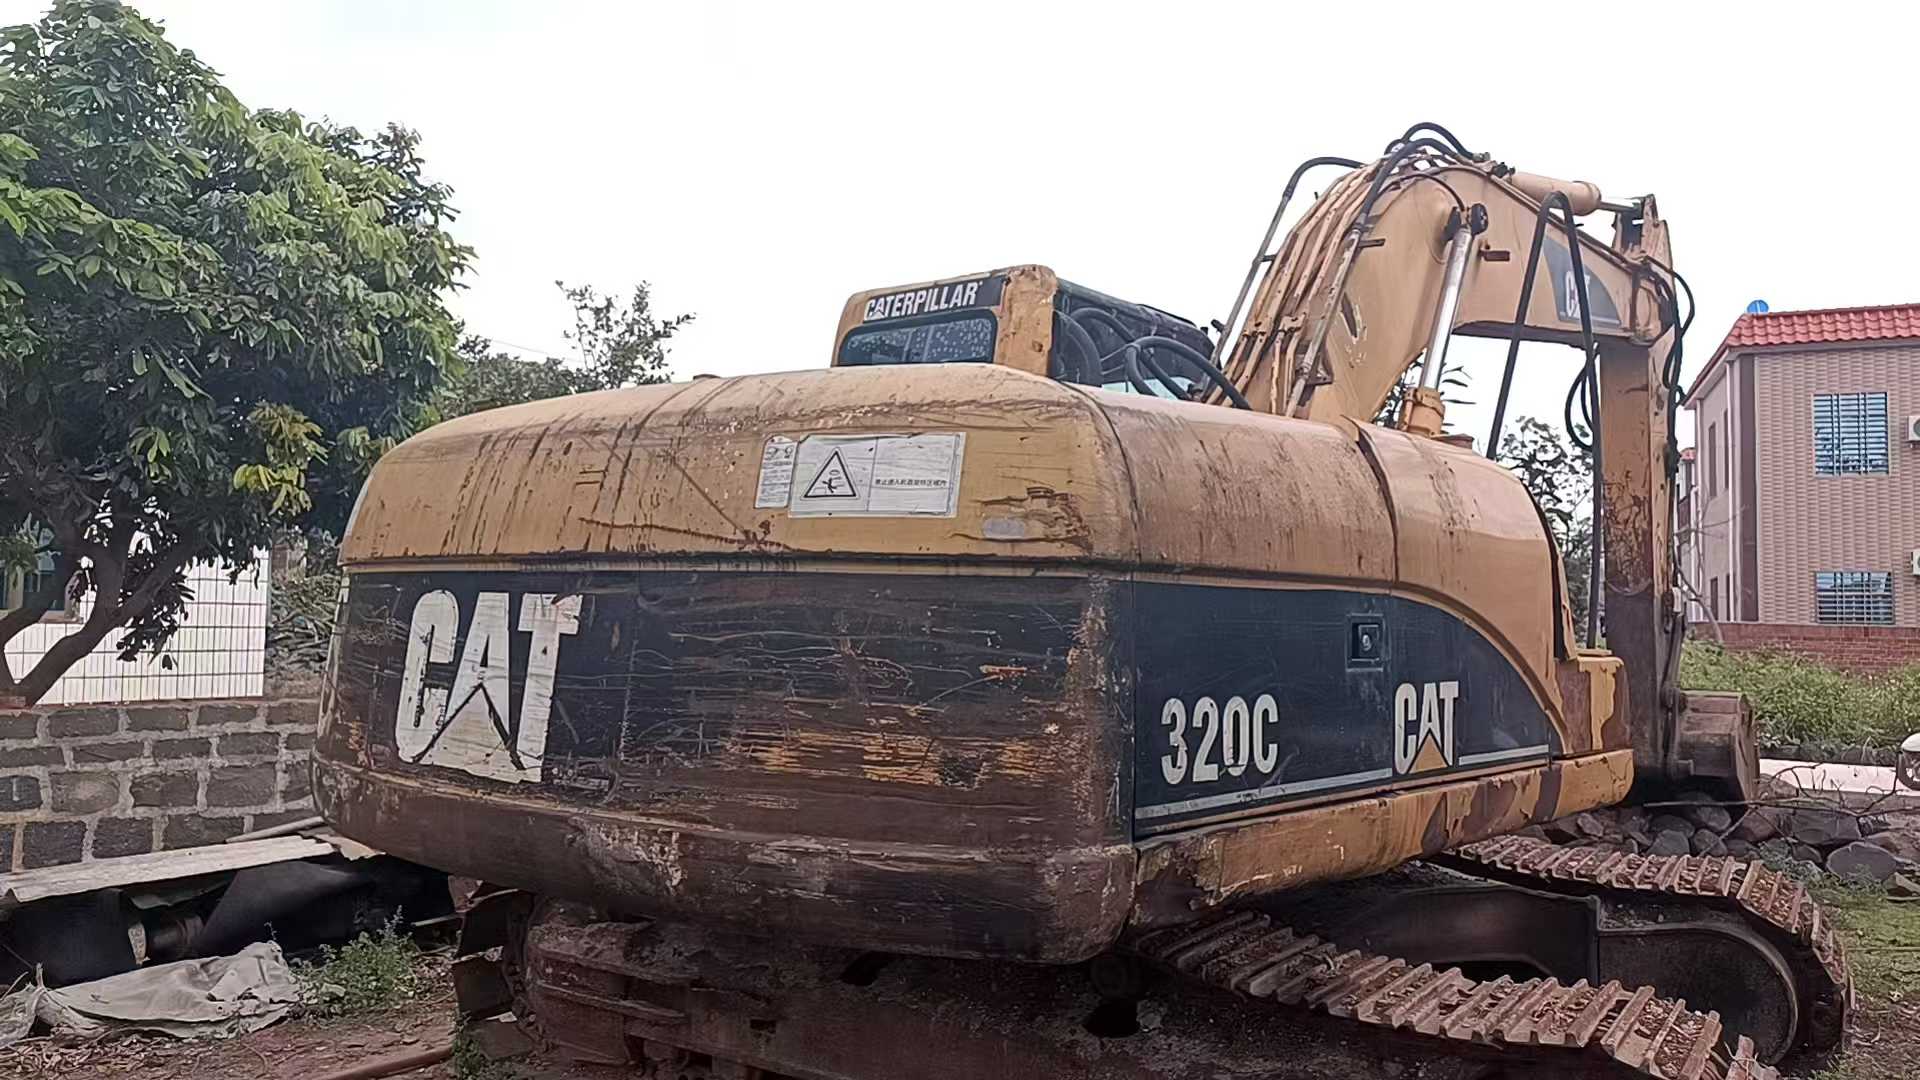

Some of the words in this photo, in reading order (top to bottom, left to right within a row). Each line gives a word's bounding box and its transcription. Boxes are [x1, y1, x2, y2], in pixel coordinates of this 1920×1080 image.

[863, 281, 979, 322] CATERPILLAR
[395, 589, 583, 783] CAT
[1394, 680, 1459, 776] CAT
[1160, 693, 1279, 785] 320C
